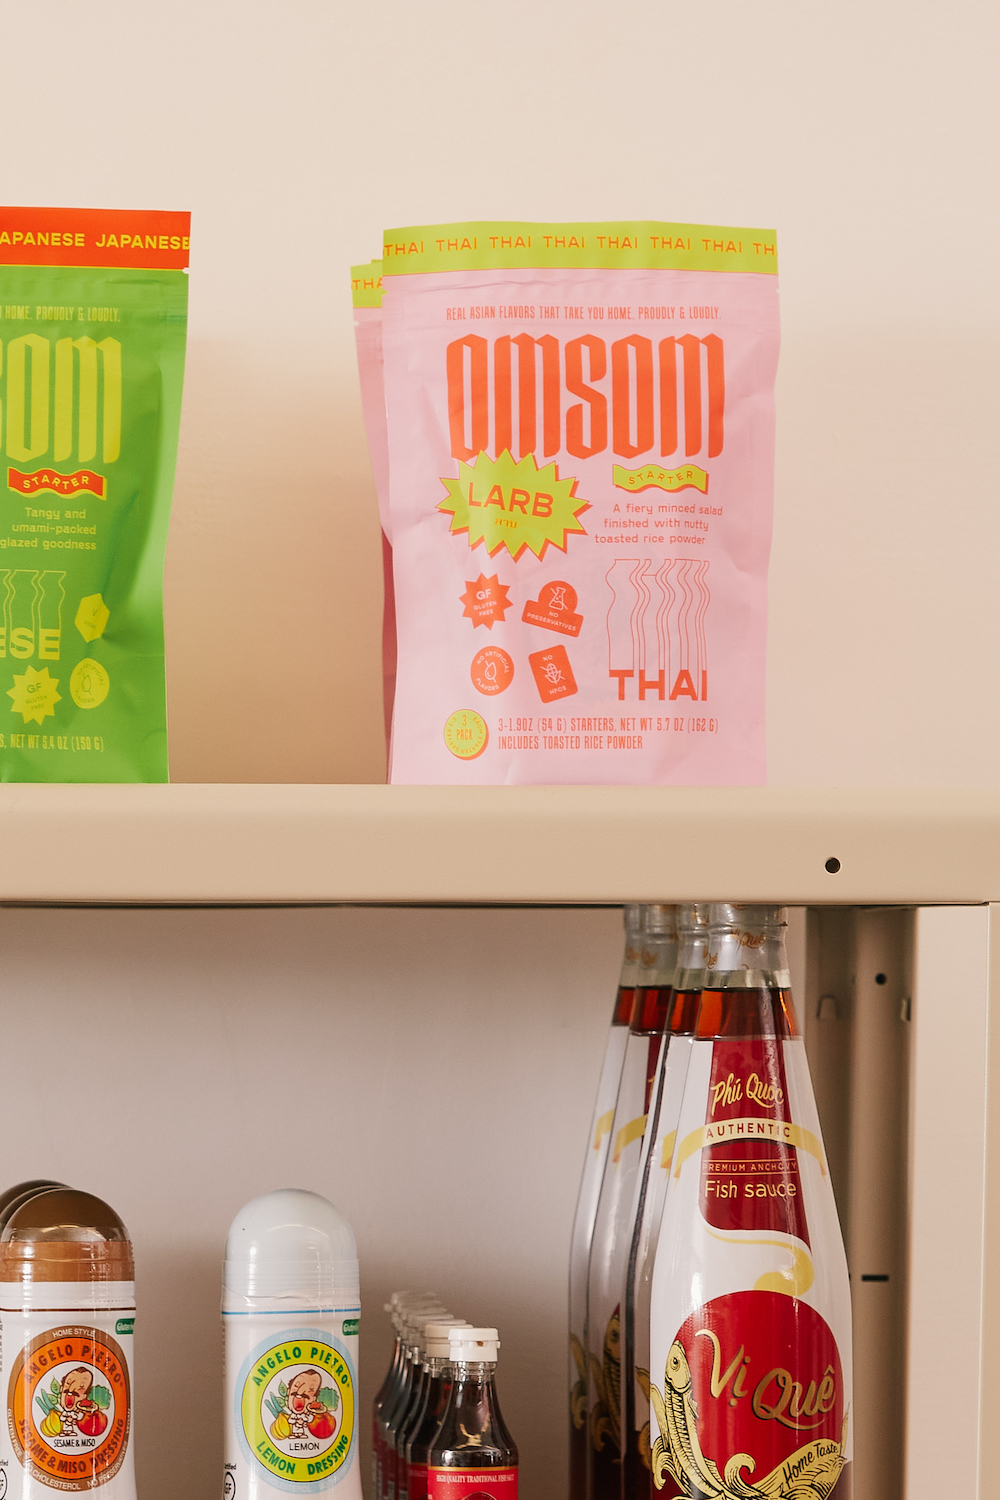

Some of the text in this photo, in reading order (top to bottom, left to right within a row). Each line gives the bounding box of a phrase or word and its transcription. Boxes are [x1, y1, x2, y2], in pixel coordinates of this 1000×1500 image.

[95, 233, 190, 250] JAPANESE
[436, 236, 638, 251] THAI THAI THAI THAI
[447, 307, 467, 321] REAL
[470, 306, 495, 320] ASIAN
[499, 306, 535, 319] FLAVORS
[539, 306, 560, 320] THAT
[564, 306, 584, 319] TAKE
[588, 306, 604, 320] YOU
[638, 307, 676, 319] PROUDLY
[679, 307, 685, 319] &
[23, 476, 89, 490] STARTER
[628, 471, 693, 485] STARTER
[468, 482, 554, 519] LARB
[25, 507, 86, 519] Tangy and
[613, 504, 723, 515] A fiery minced salad
[12, 522, 97, 536] umami-packed
[604, 518, 709, 531] finished with nutty
[0, 538, 97, 551] glazed goodness
[594, 533, 705, 545] toasted rice powder
[609, 669, 708, 702] THAI
[706, 1123, 790, 1139] AUTHENTIC
[705, 1181, 796, 1198] Fish sauce
[252, 1347, 349, 1387] ANGELO PIETRO
[695, 1329, 836, 1431] Vị Quê
[289, 1443, 320, 1451] LEMON
[256, 1434, 349, 1476] LEMON DRESSING
[783, 1442, 837, 1484] Home Taste
